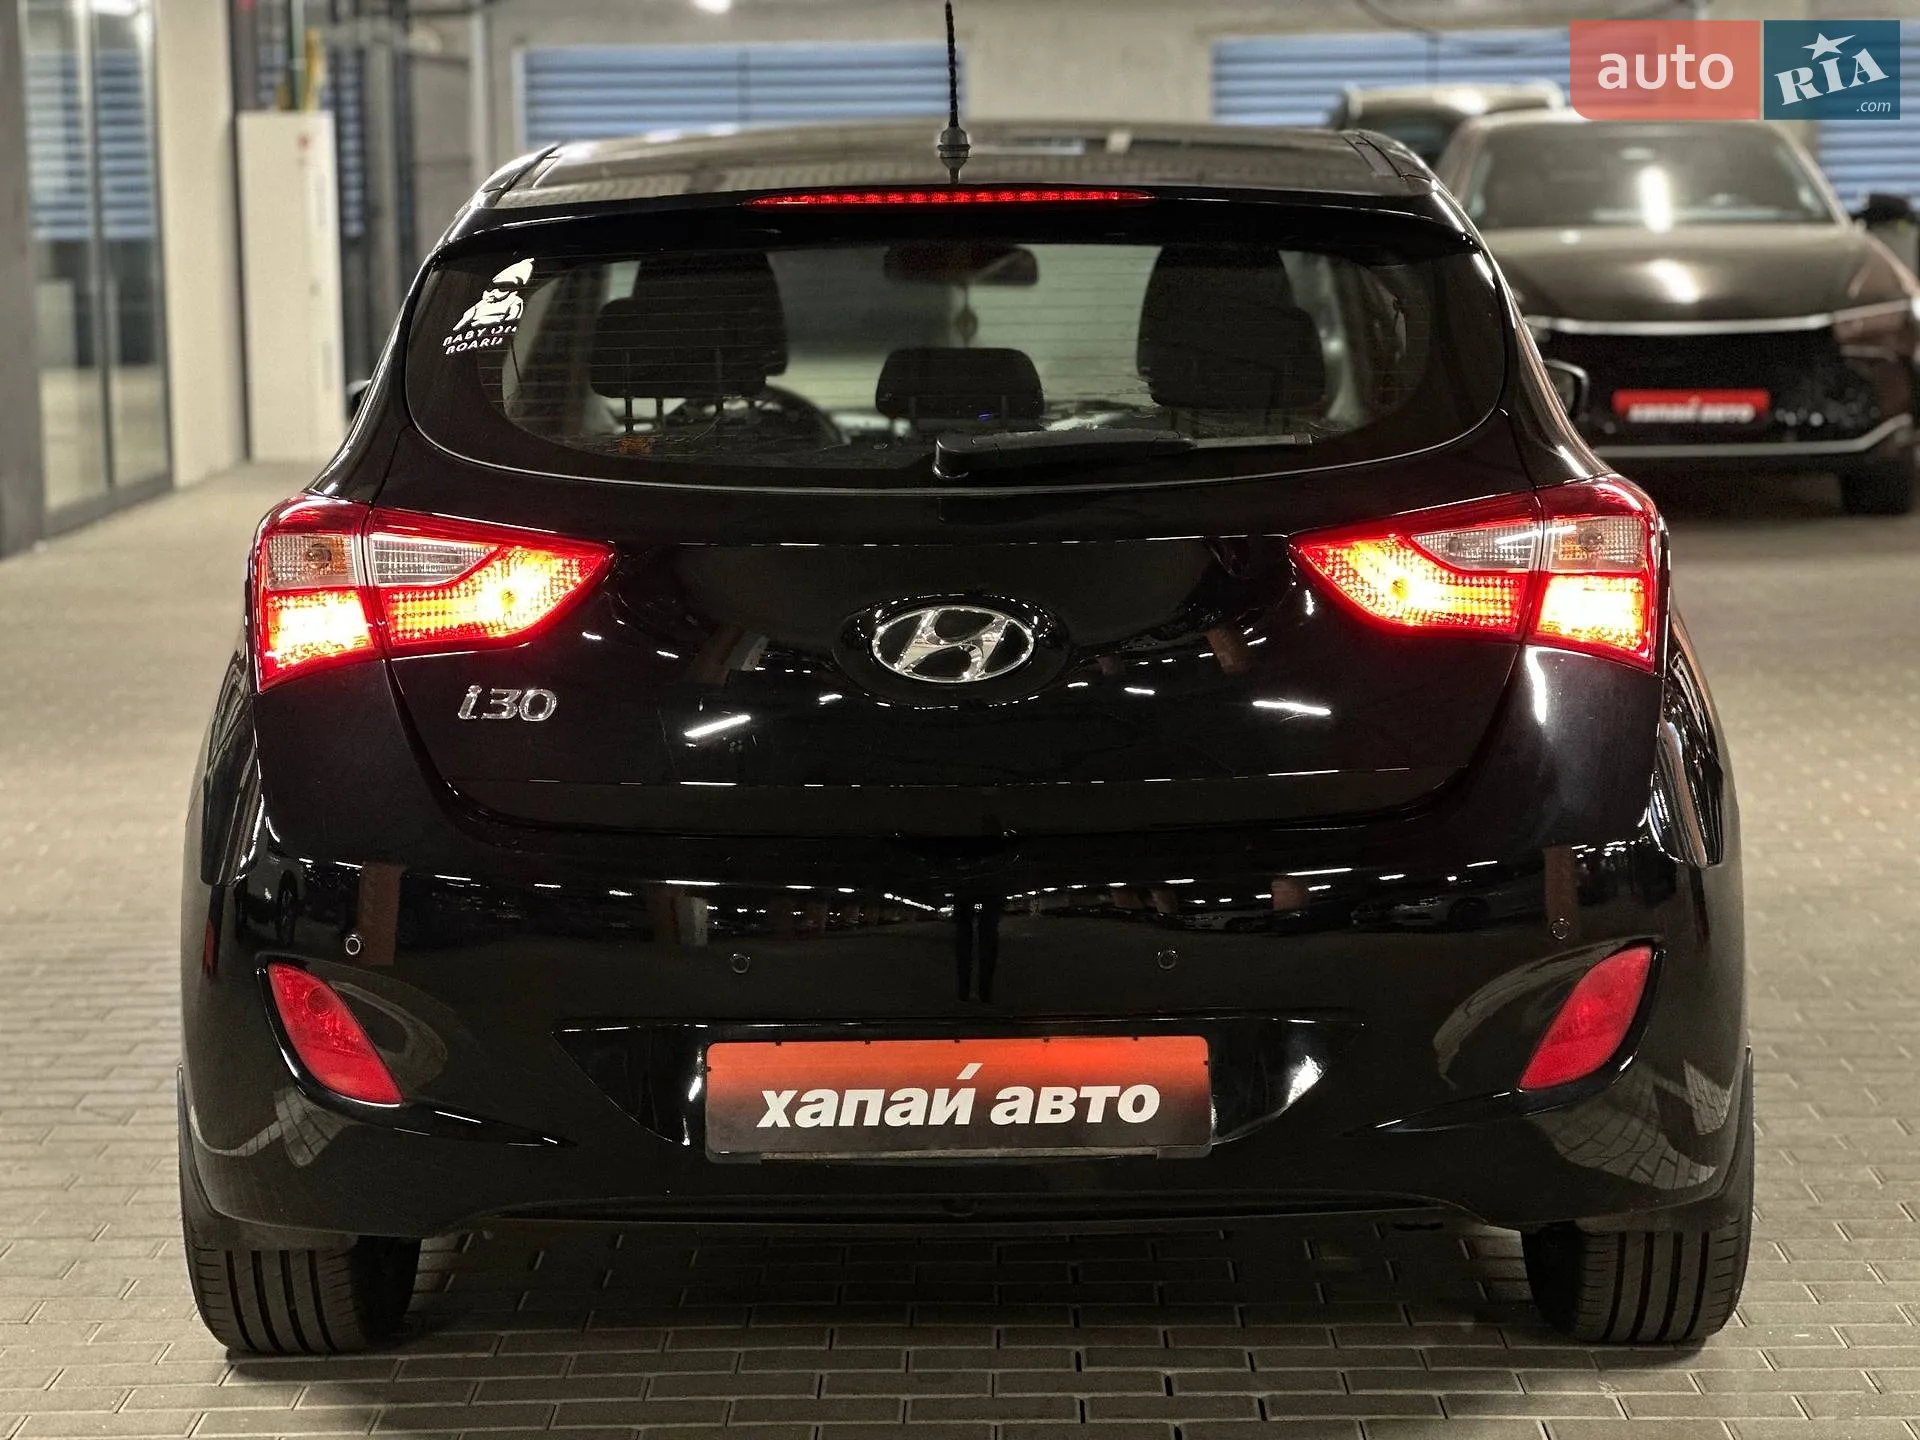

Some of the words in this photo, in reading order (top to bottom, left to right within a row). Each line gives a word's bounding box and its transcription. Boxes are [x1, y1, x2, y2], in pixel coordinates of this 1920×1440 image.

[443, 327, 487, 346] BABY
[445, 336, 503, 354] BOARD
[457, 685, 557, 721] i30
[990, 1083, 1160, 1126] авто
